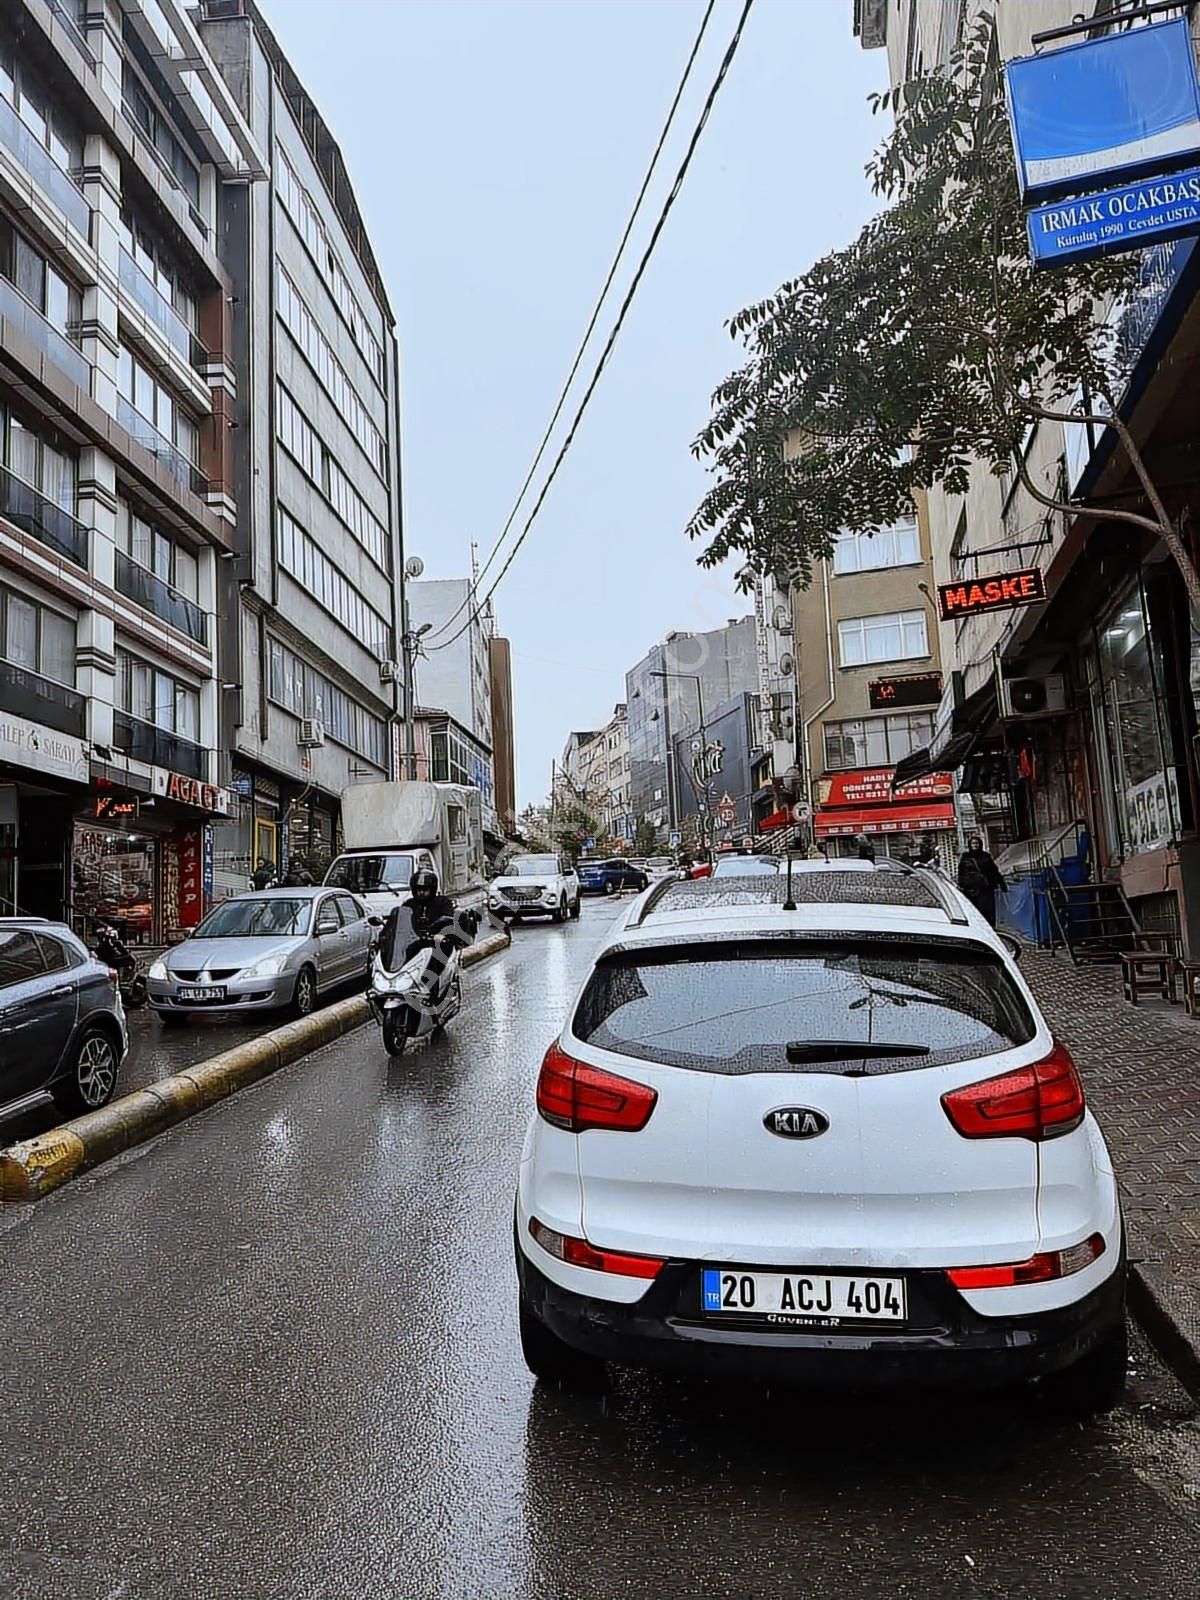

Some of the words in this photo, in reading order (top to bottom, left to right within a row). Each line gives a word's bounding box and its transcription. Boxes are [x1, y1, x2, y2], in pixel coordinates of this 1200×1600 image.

[1040, 202, 1104, 233] IRMAK
[1108, 177, 1200, 217] OCAKBAŞ
[1057, 231, 1098, 248] Kuruluş
[1100, 223, 1123, 238] 1990
[1128, 214, 1164, 231] Cevdet
[1167, 206, 1198, 222] USTA
[945, 575, 1037, 610] MASKE
[183, 831, 198, 904] KASAP
[774, 1112, 820, 1133] KIA
[706, 1292, 720, 1304] TR
[722, 1275, 756, 1308] 20
[780, 1277, 832, 1312] ACJ
[846, 1280, 900, 1316] 404
